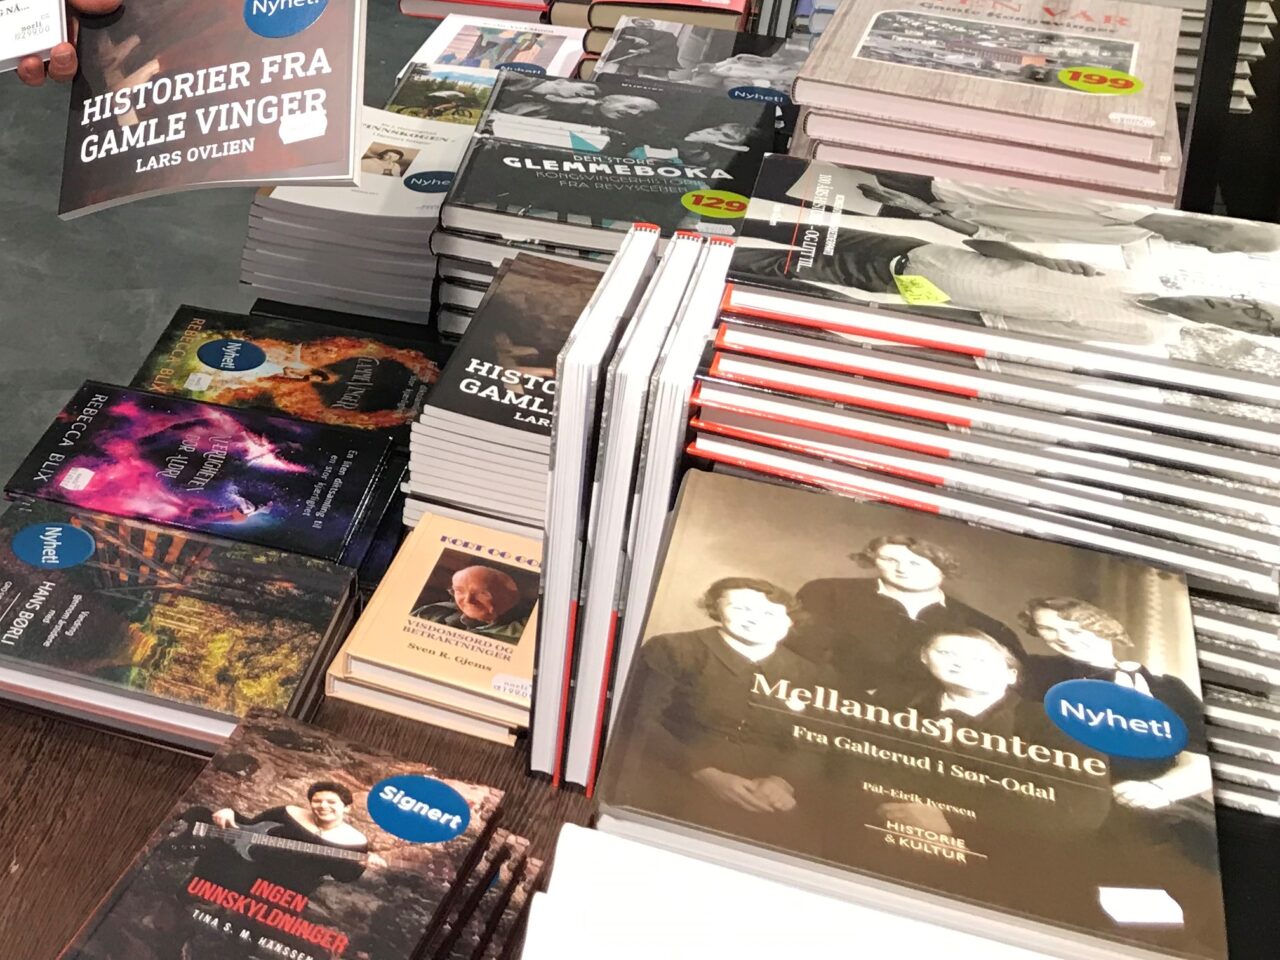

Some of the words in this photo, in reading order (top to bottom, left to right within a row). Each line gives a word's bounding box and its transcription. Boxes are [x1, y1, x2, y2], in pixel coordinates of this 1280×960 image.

[920, 1, 981, 17] Gamle
[986, 10, 1118, 34] Kongsvinger
[79, 60, 251, 126] HISTORIER
[260, 47, 332, 84] FRA
[734, 89, 784, 103] Nyhet!
[1069, 69, 1135, 90] 199
[79, 111, 188, 164] GAMLE
[195, 87, 328, 134] VINGER
[135, 150, 182, 173] LARS
[186, 137, 256, 163] OVLIEN
[502, 156, 734, 180] GLEMMEBOKA
[573, 154, 600, 163] DEN
[606, 155, 656, 167] STORE
[560, 179, 591, 190] FRA
[690, 193, 748, 213] 129
[167, 317, 206, 364] REBECCA
[221, 342, 243, 370] Nyhet!
[149, 367, 175, 392] BLIX
[465, 357, 557, 396] HISTO
[459, 377, 555, 416] GAML
[60, 392, 111, 448] REBECCA
[513, 411, 554, 427] LAR
[32, 452, 66, 483] BLIX
[301, 482, 327, 517] kjærlighet
[320, 476, 344, 518] diktsamling
[39, 526, 63, 564] Nyhet!
[439, 535, 484, 552] KORT
[487, 547, 512, 560] OG
[515, 555, 543, 569] GO
[25, 581, 56, 611] HANS
[1, 610, 35, 646] BØRLI
[402, 625, 513, 663] BETRAKTNINGER
[407, 618, 494, 649] VISDOMSORD
[494, 643, 515, 655] OG
[406, 642, 437, 656] Sven
[439, 649, 452, 660] R.
[454, 655, 493, 673] Gjems
[750, 670, 1109, 778] Mellandsjentene
[1058, 697, 1173, 740] Nyhet!
[791, 722, 830, 748] Fra
[833, 734, 931, 772] Galterud
[936, 758, 945, 775] i
[950, 761, 1057, 803] Sør-Odal
[378, 783, 464, 831] Signert
[925, 796, 978, 820] Iversen
[884, 832, 896, 845] &
[897, 835, 969, 864] KULTUR
[885, 819, 967, 849] HISTORIE
[249, 877, 310, 911] INGEN
[186, 875, 351, 954] UNNSKYLDNINGER
[191, 907, 220, 930] TINA
[222, 920, 235, 935] S.
[238, 926, 255, 944] M.
[257, 933, 316, 960] HANSSEN
